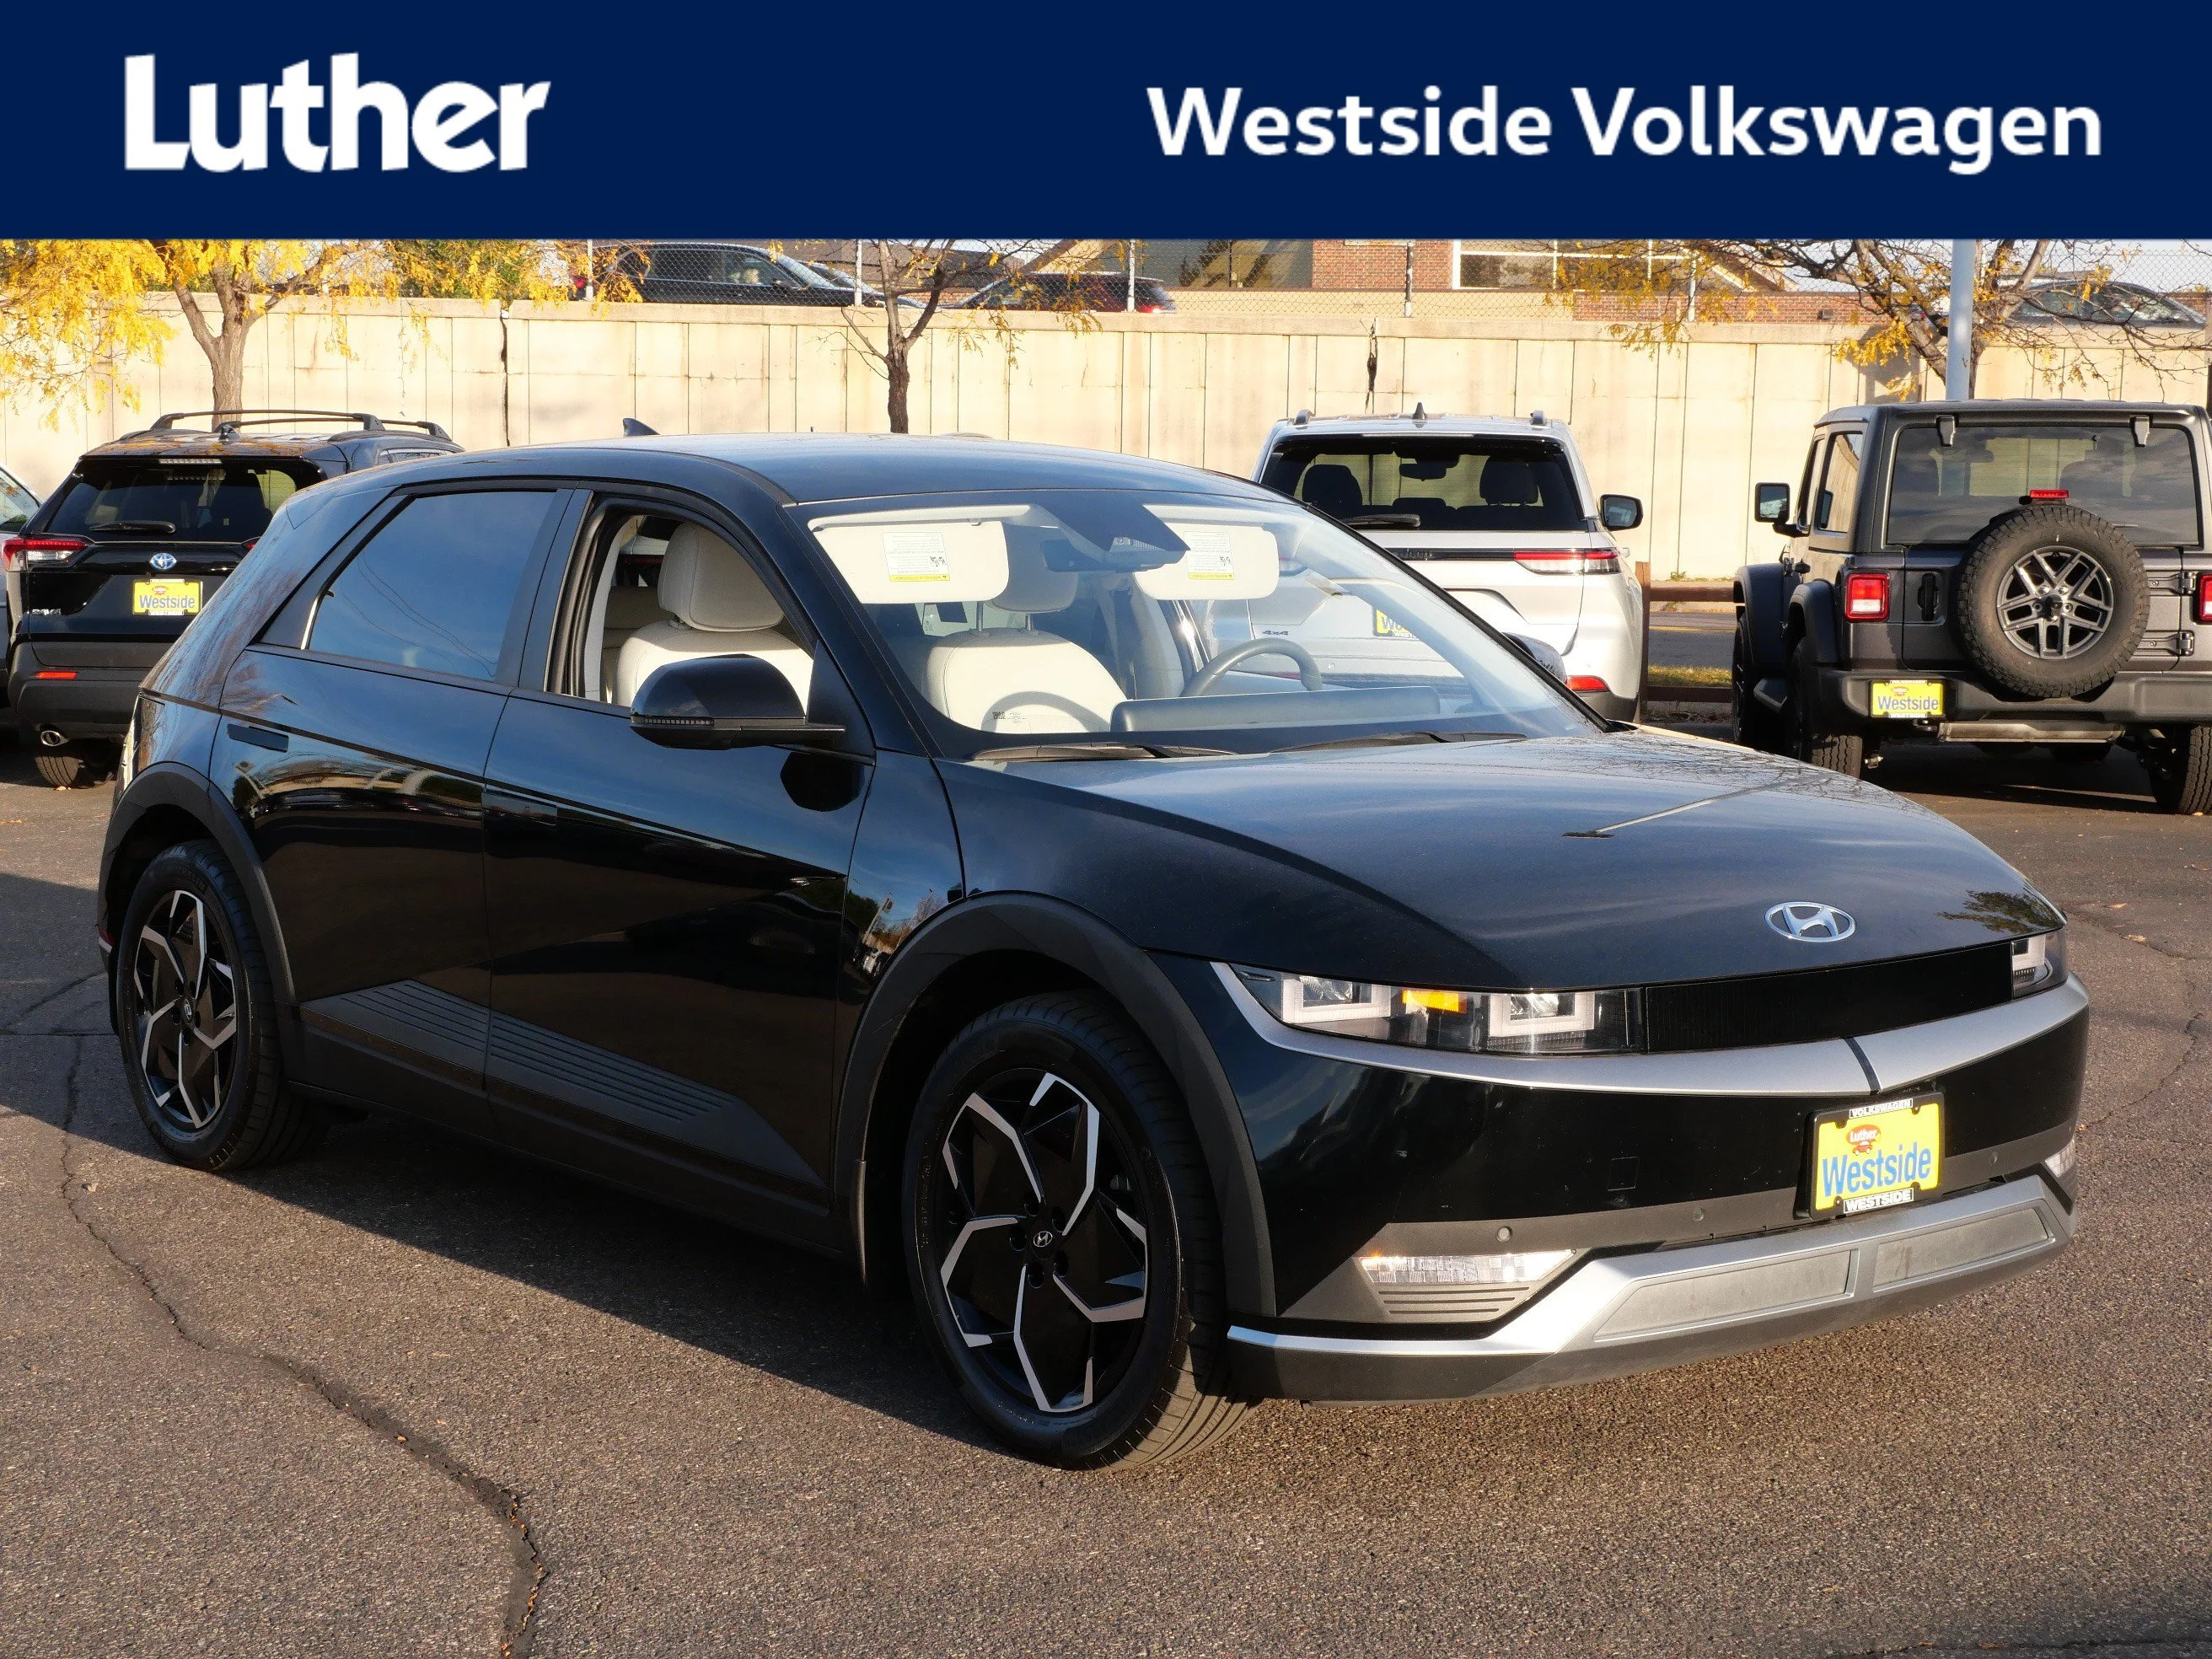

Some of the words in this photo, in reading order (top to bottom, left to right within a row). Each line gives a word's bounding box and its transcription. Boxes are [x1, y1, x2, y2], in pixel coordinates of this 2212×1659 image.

[139, 595, 195, 609] Westside
[1877, 696, 1939, 711] Westside
[1851, 1099, 1911, 1118] VOLKSWAGEN
[1850, 1129, 1878, 1143] Luther
[1823, 1141, 1932, 1197] Westside
[1846, 1189, 1911, 1211] WESTSIDE
